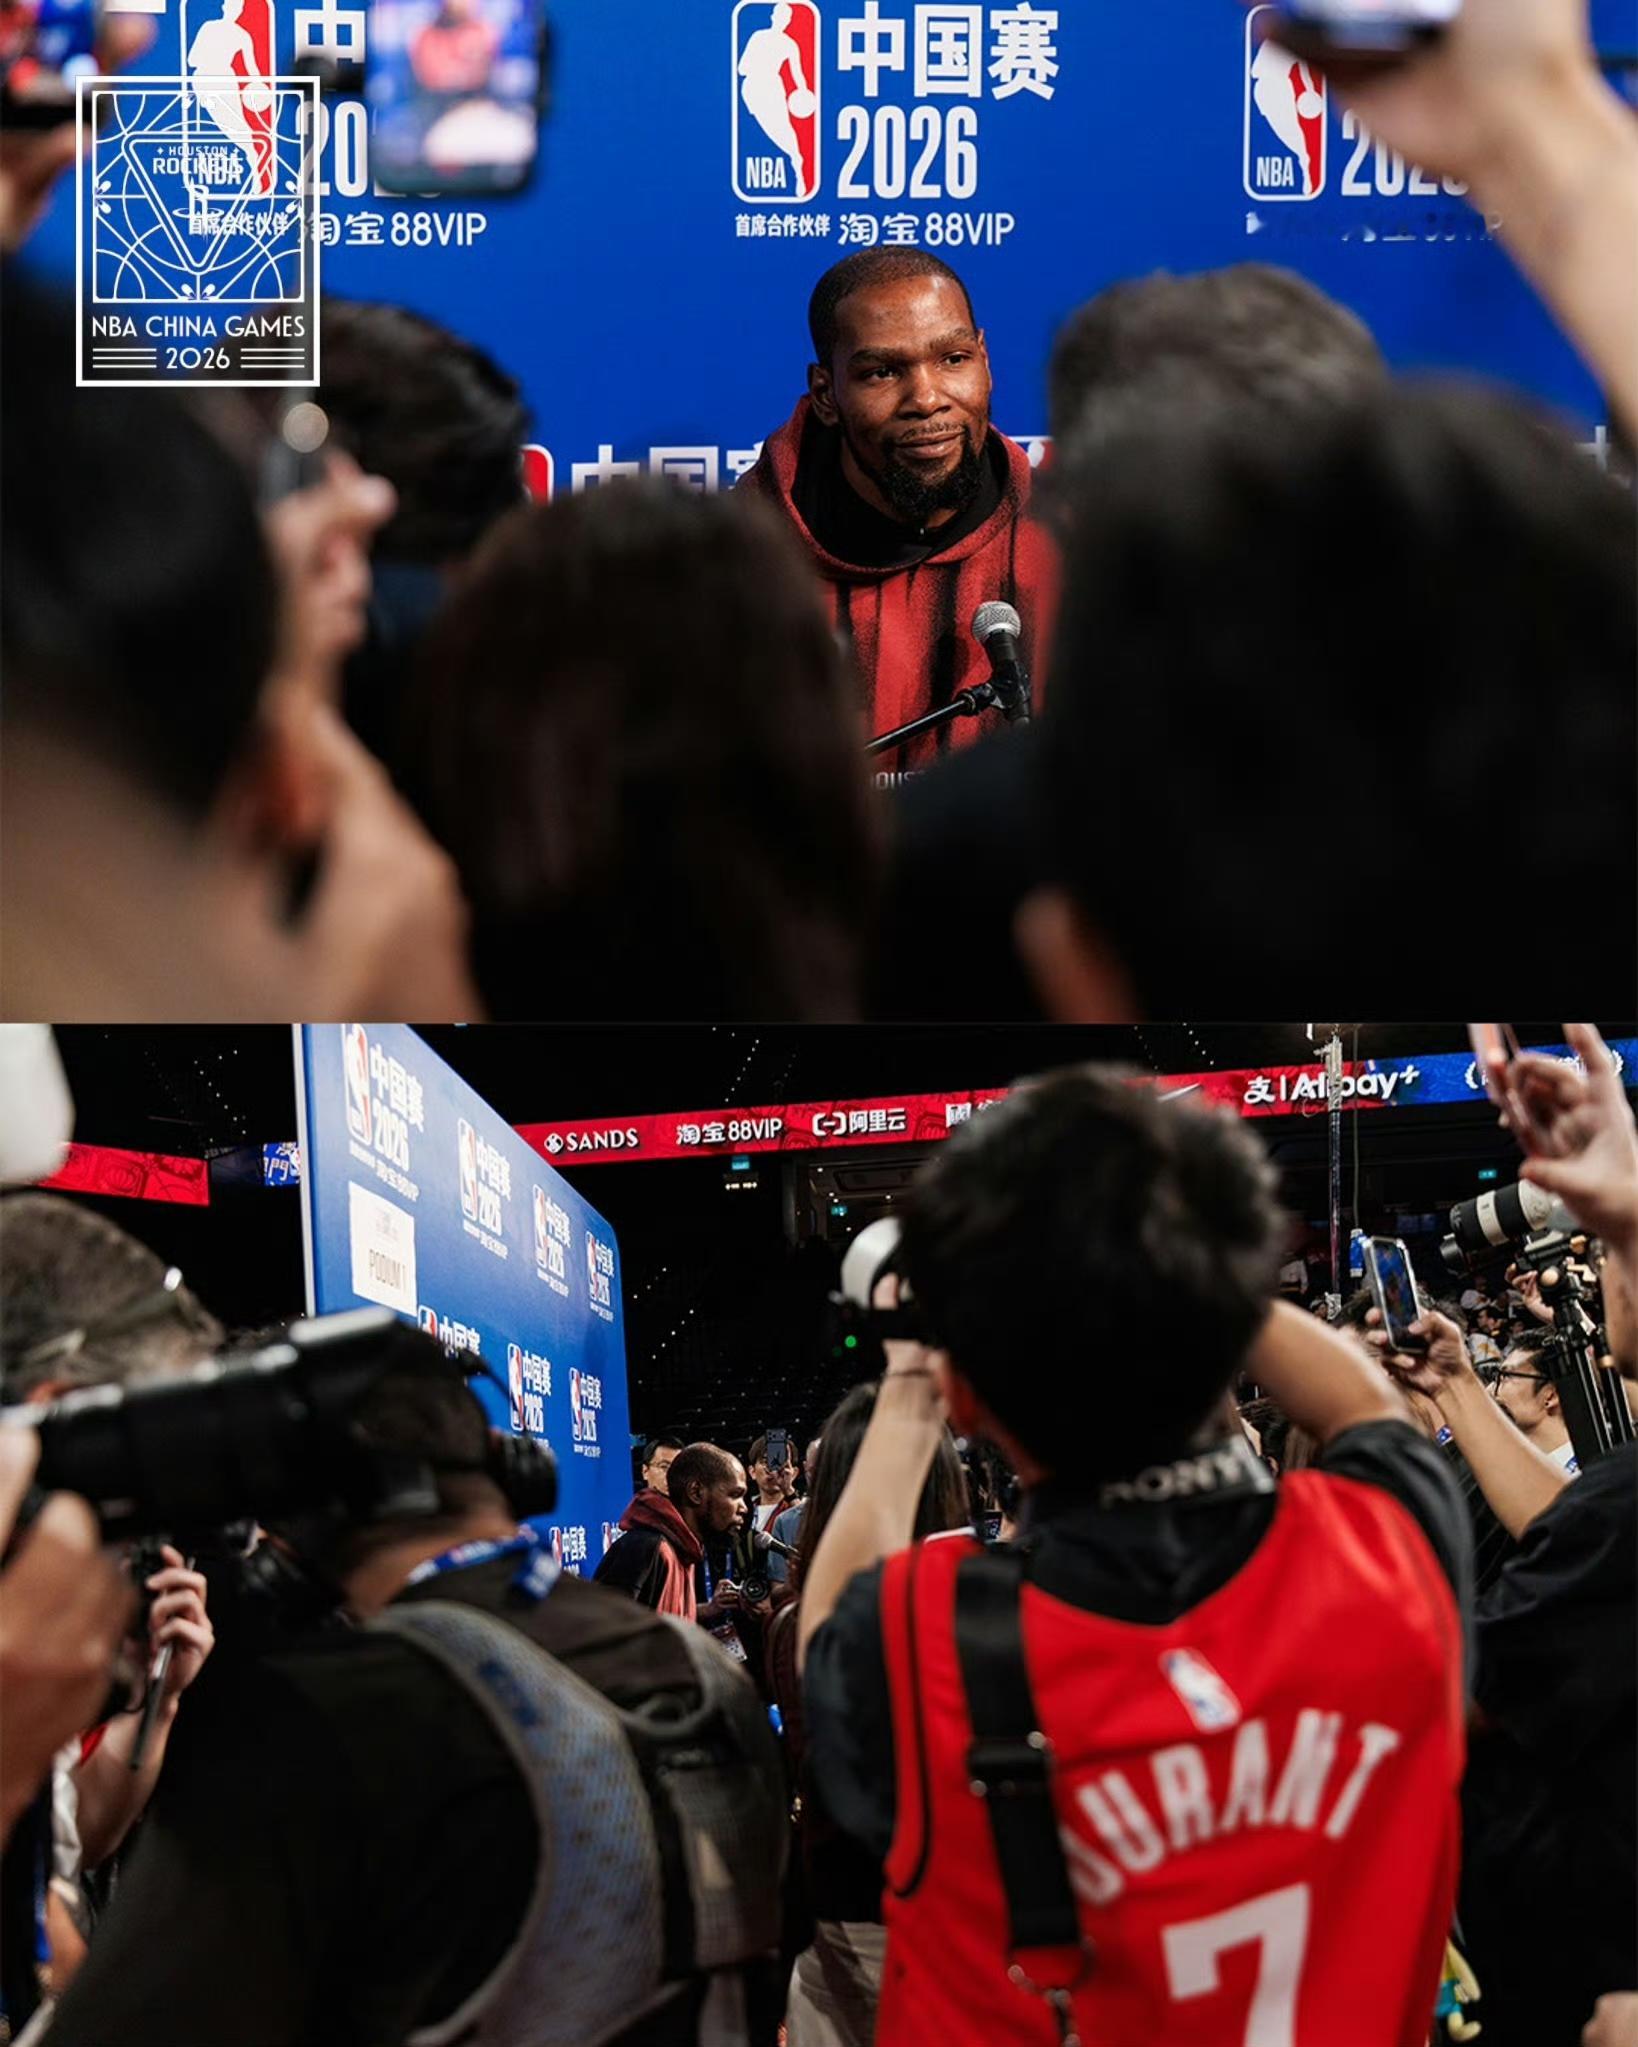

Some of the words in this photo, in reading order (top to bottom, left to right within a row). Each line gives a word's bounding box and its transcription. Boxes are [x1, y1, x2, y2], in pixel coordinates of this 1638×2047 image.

[837, 0, 1060, 101] 中国赛
[837, 105, 979, 199] 2026
[1341, 108, 1470, 196] 20
[746, 156, 787, 189] NBA
[1256, 156, 1295, 187] NBA
[734, 213, 832, 238] 首席合作伙伴
[1243, 1075, 1276, 1104] 支
[1290, 1064, 1420, 1101] Alpay+
[848, 1108, 907, 1134] 阿里云
[566, 1128, 638, 1152] SANDS
[1162, 1882, 1312, 2047] 7
